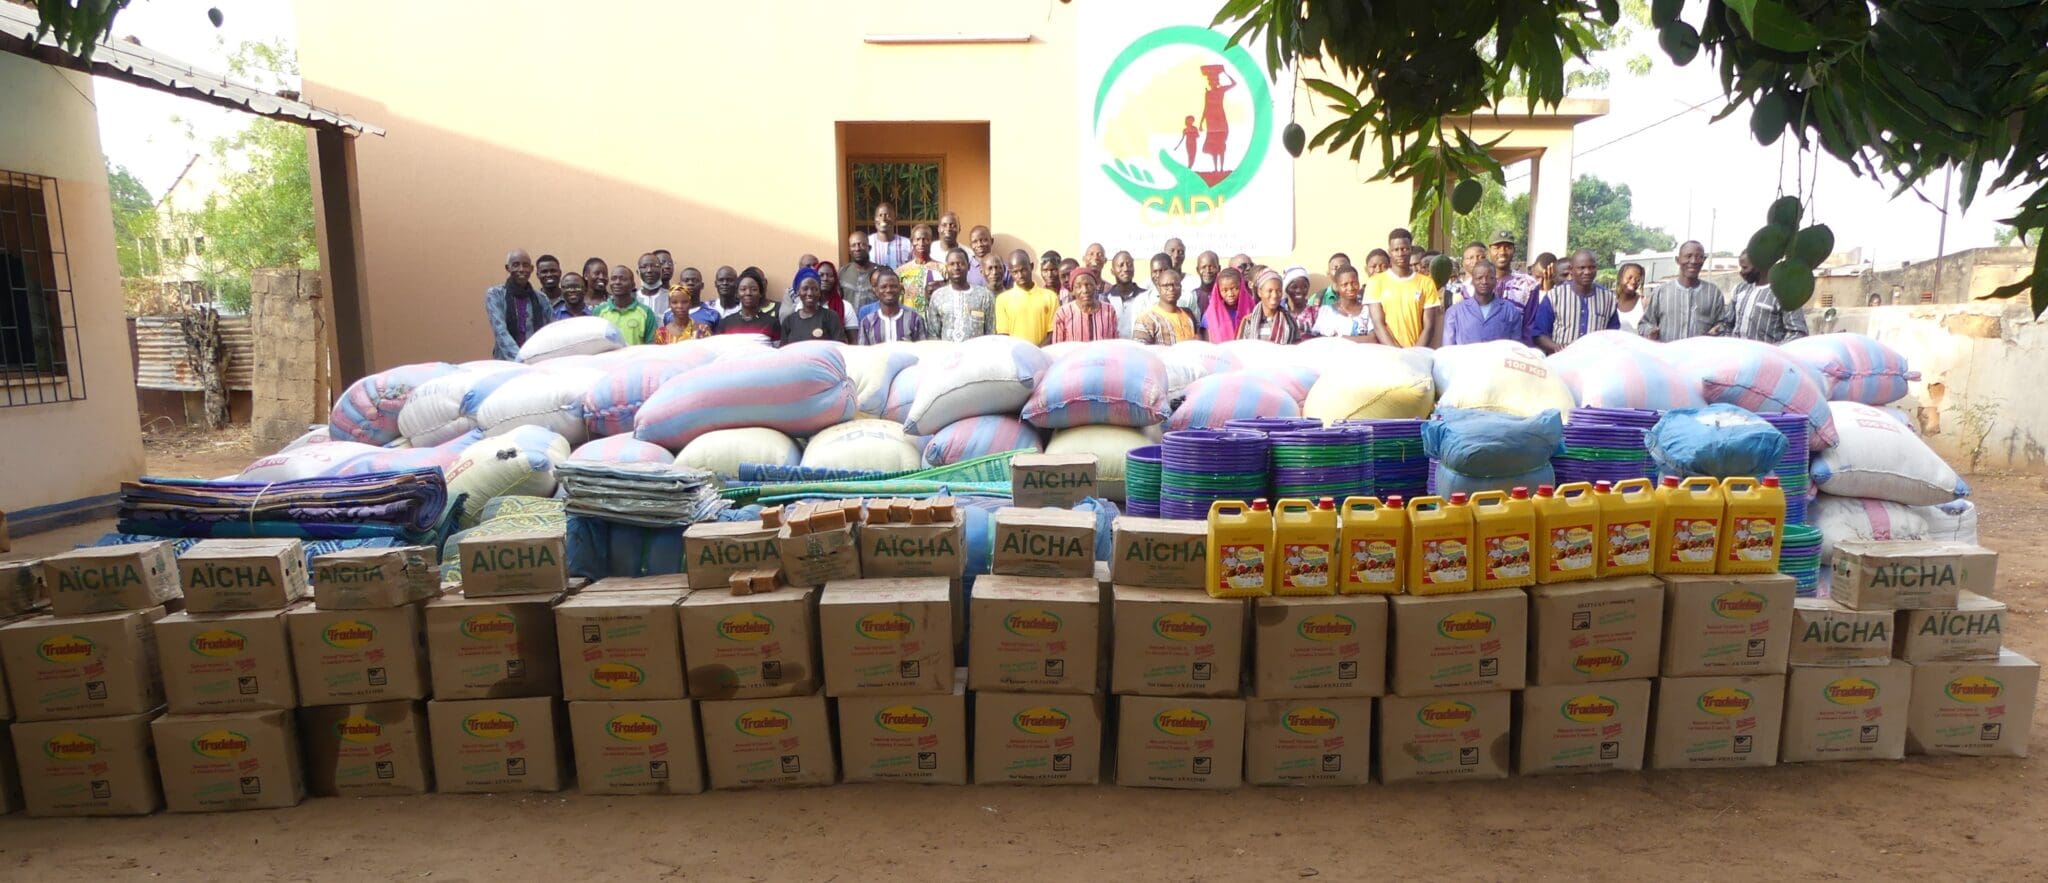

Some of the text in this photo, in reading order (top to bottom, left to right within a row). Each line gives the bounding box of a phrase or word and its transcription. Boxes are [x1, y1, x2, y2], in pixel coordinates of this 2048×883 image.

[1141, 194, 1225, 226] CADI
[1023, 470, 1092, 489] AÏCHA
[700, 539, 780, 565] AÏCHA
[874, 531, 955, 557] AÏCHA
[1003, 528, 1084, 557] AÏCHA
[1125, 537, 1206, 562] AÏCHA
[471, 543, 556, 573] AÏCHA
[59, 564, 141, 593] AÏCHA
[190, 563, 276, 588] AÏCHA
[1870, 563, 1955, 588] AÏCHA
[1803, 617, 1886, 643] AÏCHA
[1919, 612, 2000, 636] AÏCHA
